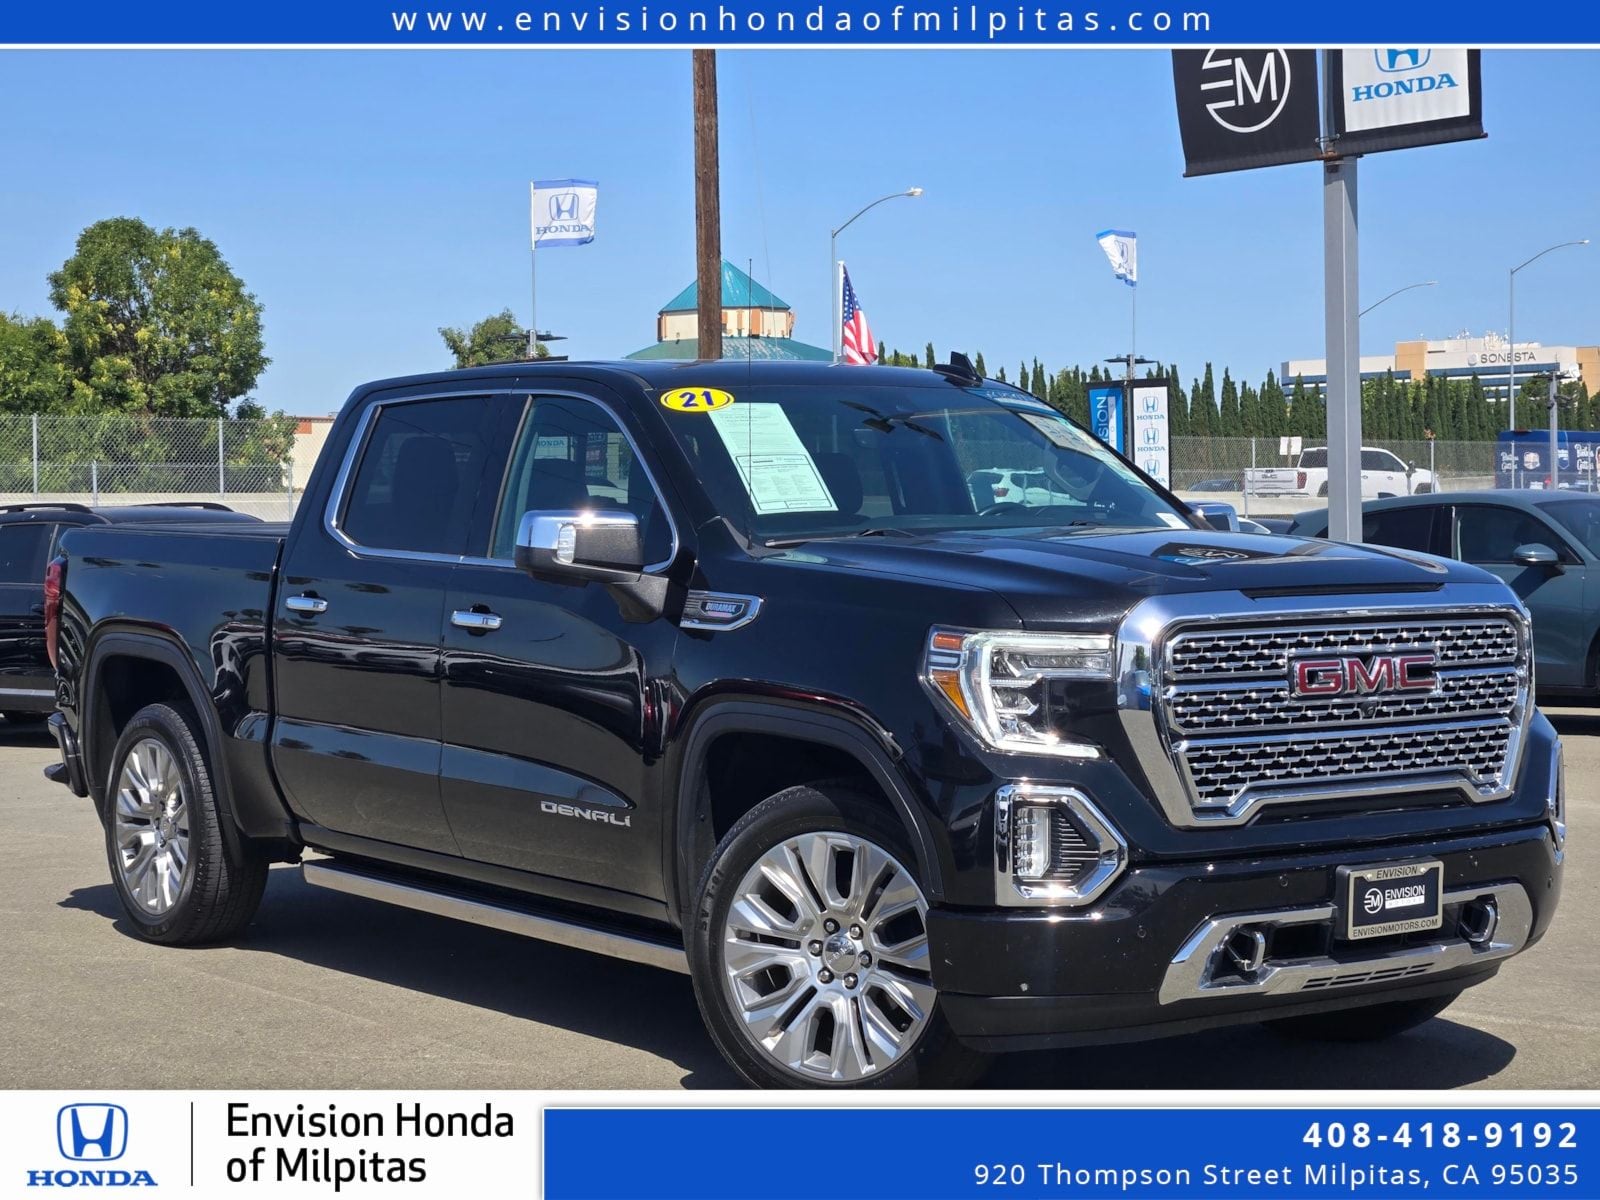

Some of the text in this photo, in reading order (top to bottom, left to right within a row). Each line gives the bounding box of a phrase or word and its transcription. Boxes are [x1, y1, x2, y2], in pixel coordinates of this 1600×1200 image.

[1352, 73, 1459, 101] HONDA
[536, 224, 593, 235] HONDA
[1480, 352, 1537, 364] SONESTA
[679, 390, 714, 408] 21
[705, 602, 737, 613] DURAMAX
[1297, 654, 1437, 695] GMC
[541, 800, 631, 828] DENALI
[1376, 866, 1418, 879] ENVISION
[1385, 885, 1425, 900] ENVISION
[1353, 919, 1438, 938] ENVISIONMOTORS.COM
